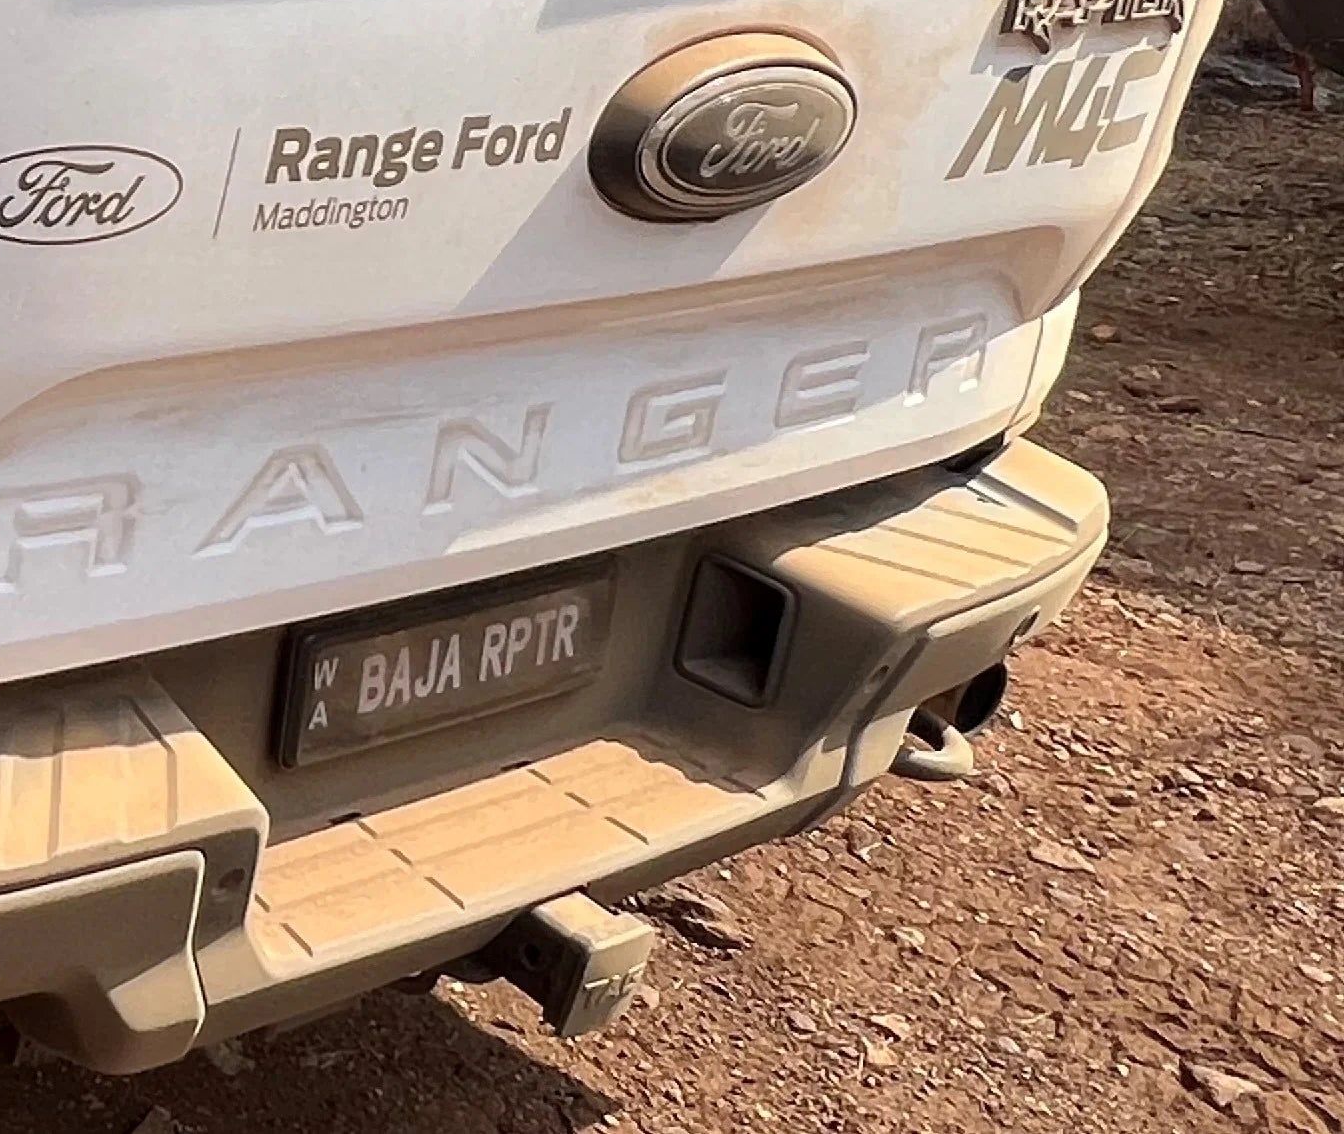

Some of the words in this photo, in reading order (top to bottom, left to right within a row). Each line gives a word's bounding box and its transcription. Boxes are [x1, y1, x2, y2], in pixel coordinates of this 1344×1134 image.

[264, 126, 444, 188] Range
[450, 106, 573, 170] Ford
[699, 101, 822, 179] Ford
[252, 195, 410, 232] Maddington
[356, 633, 461, 714] BAJA
[478, 604, 579, 682] RPTR
